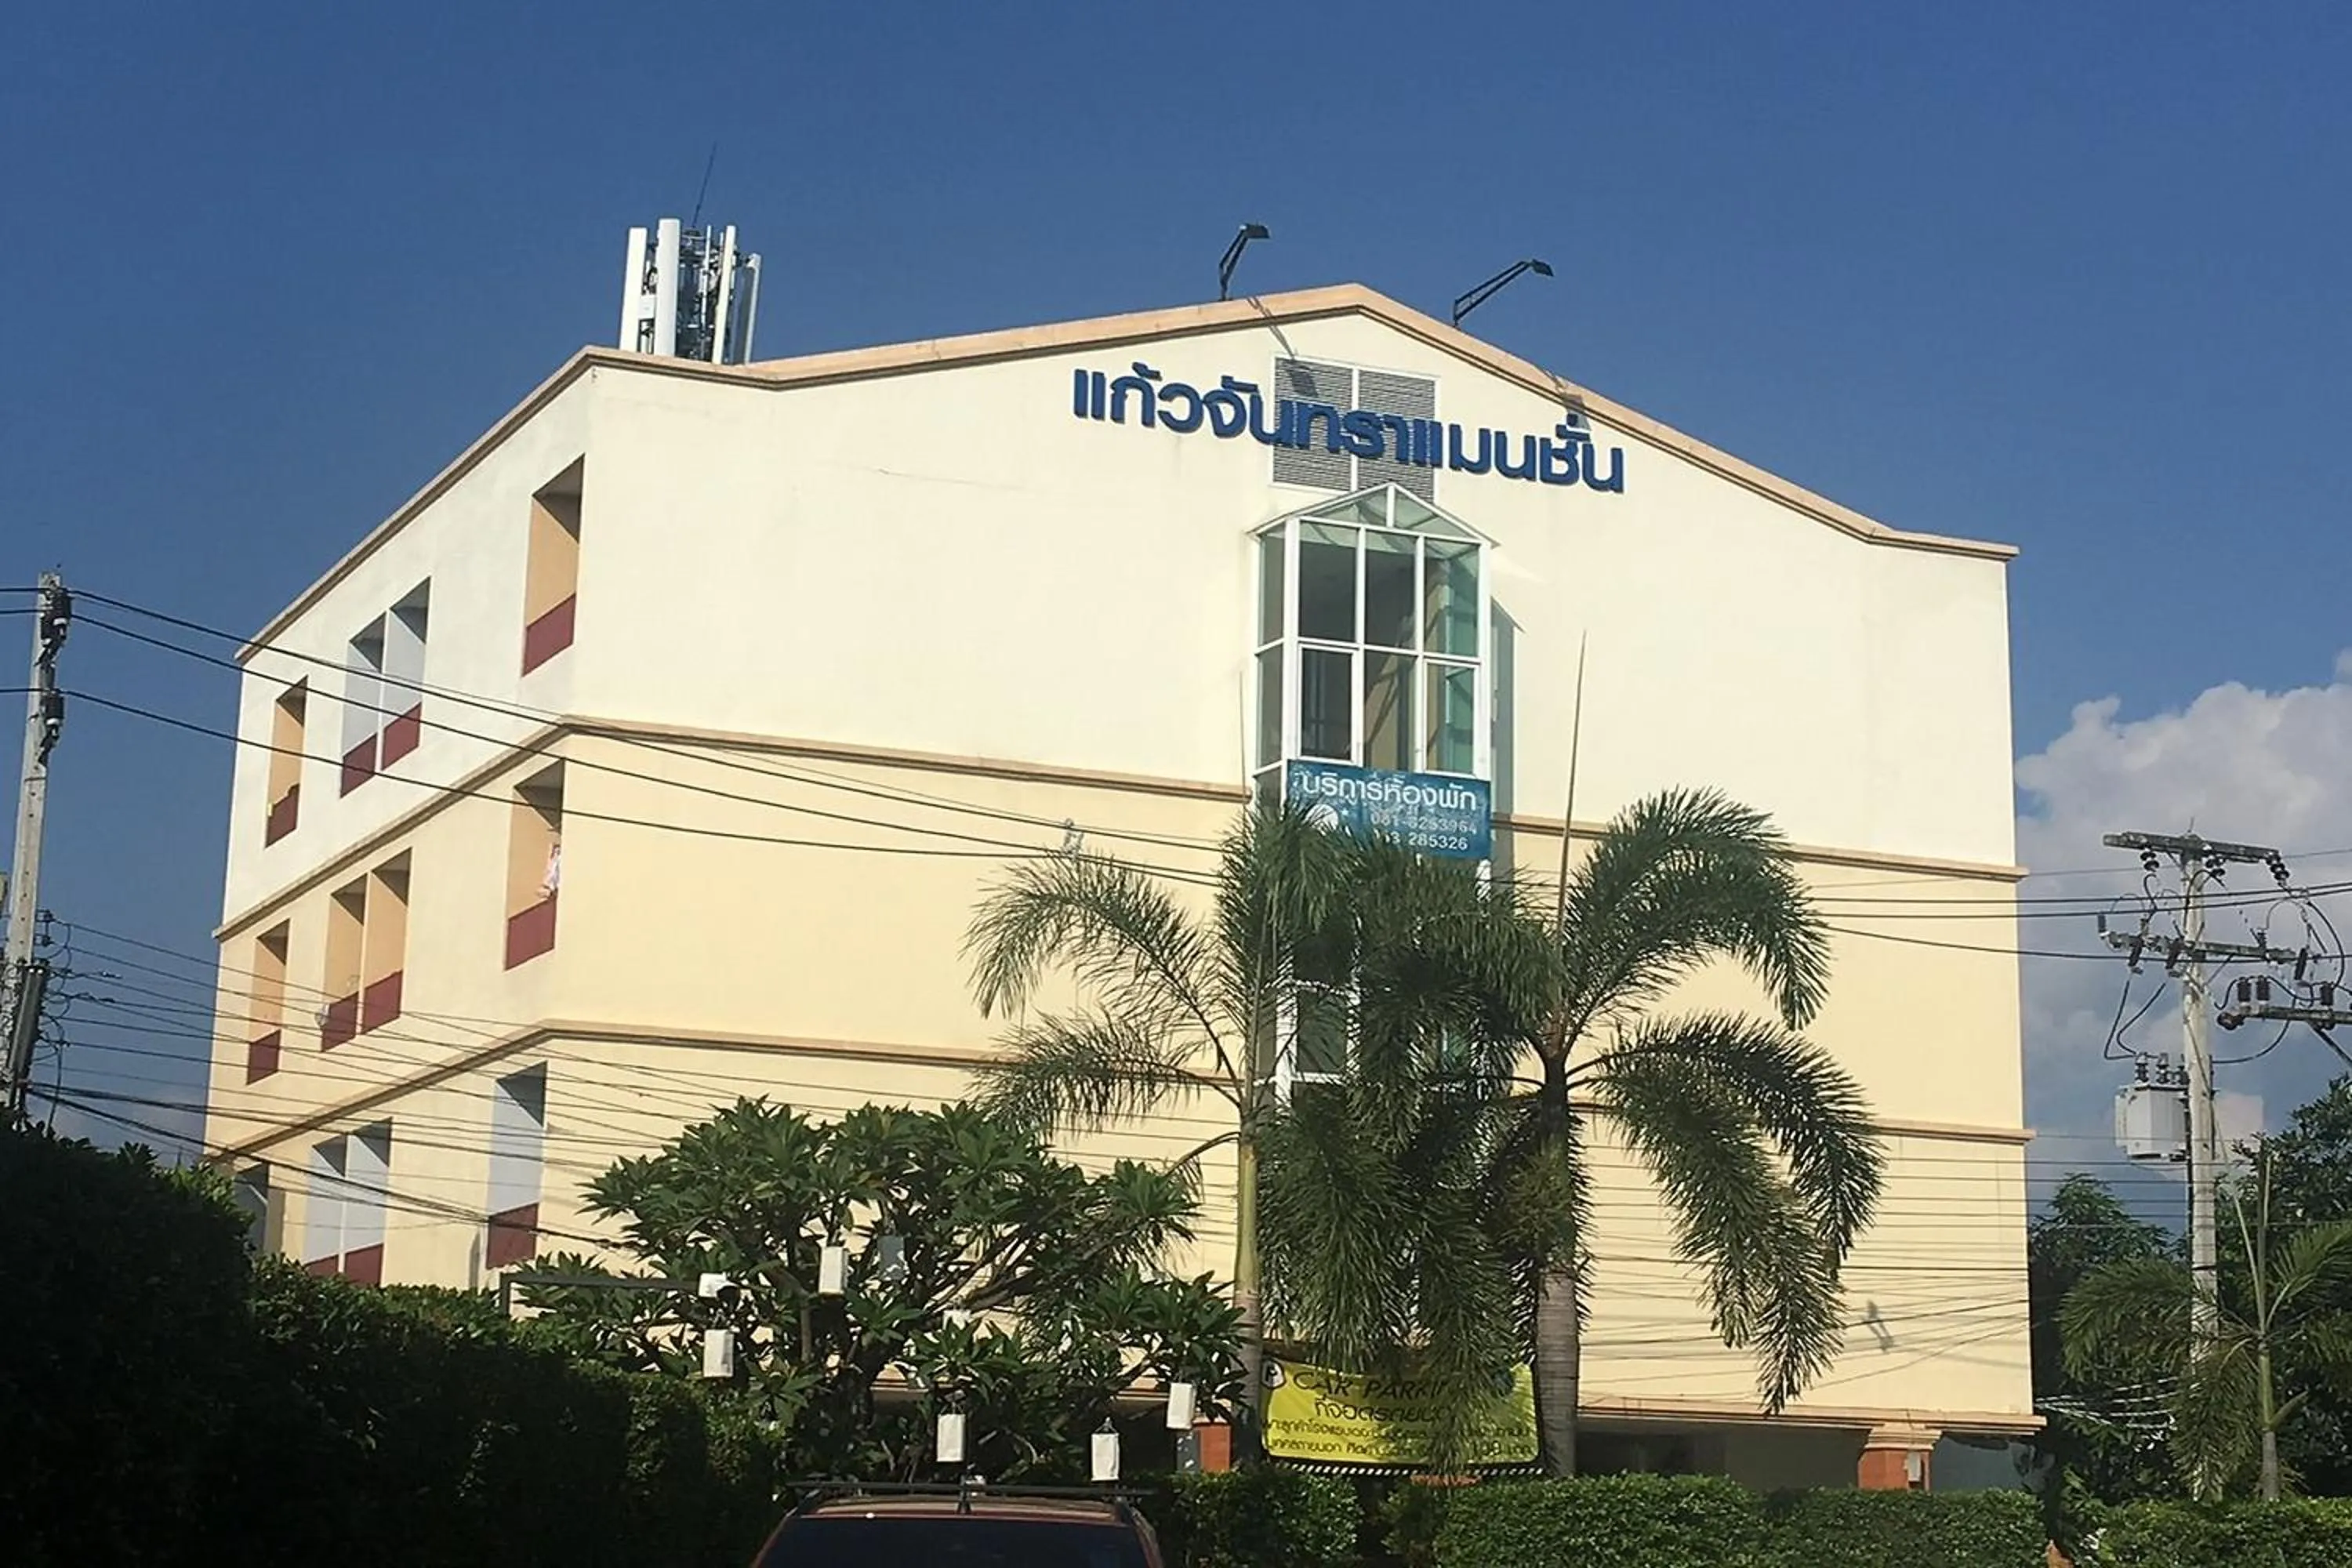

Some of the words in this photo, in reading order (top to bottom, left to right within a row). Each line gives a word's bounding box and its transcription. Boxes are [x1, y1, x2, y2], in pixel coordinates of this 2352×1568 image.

[1073, 361, 1625, 495] แก้วจันทราแมนชั่น
[1408, 832, 1468, 851] 285326
[1293, 1370, 1353, 1397] CAR
